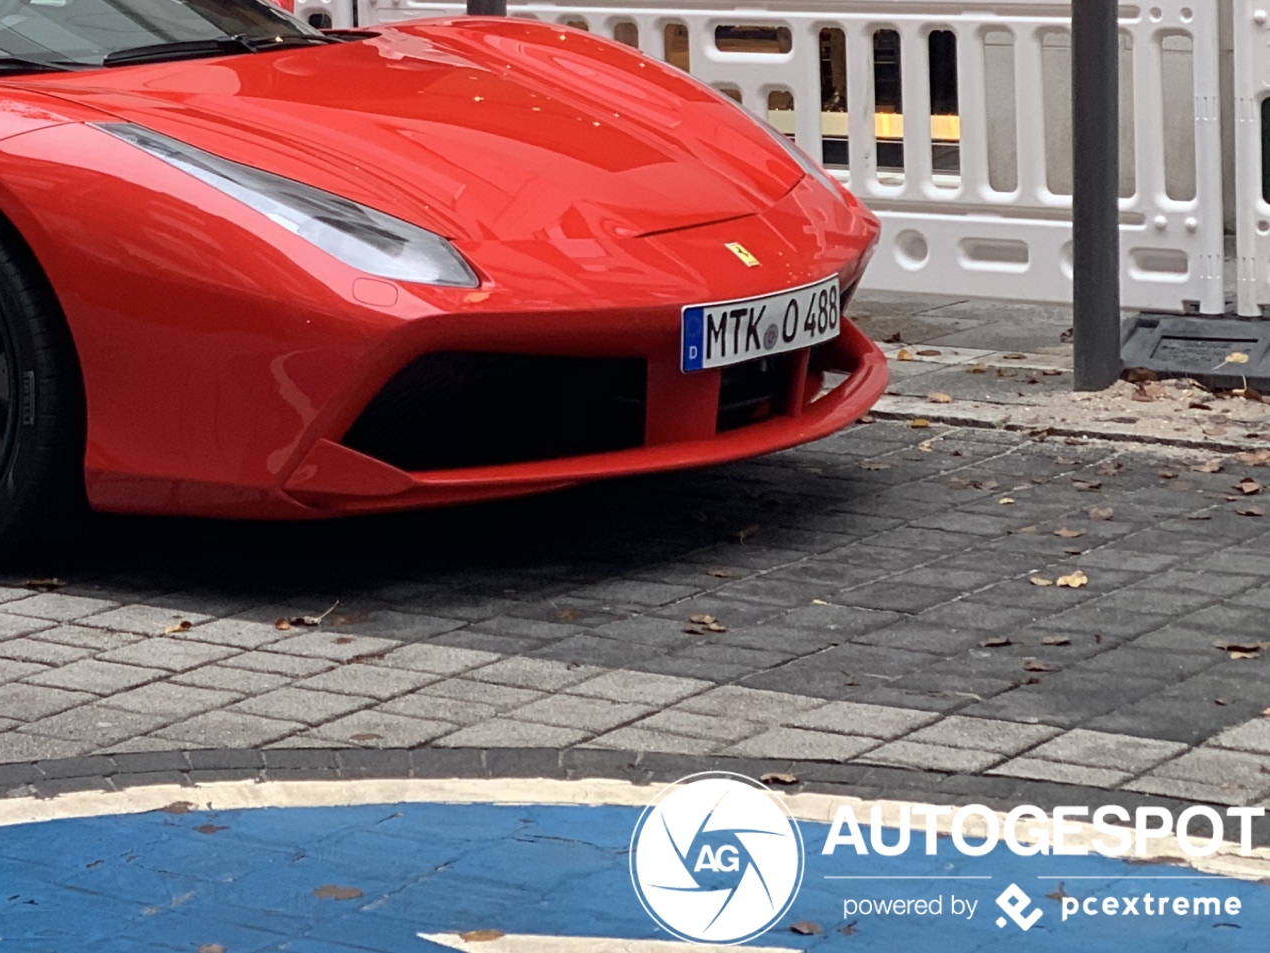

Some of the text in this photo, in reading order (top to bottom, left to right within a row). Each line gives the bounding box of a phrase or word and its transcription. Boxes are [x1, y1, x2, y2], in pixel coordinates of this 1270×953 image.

[706, 305, 767, 360] MTK
[803, 284, 838, 338] 488
[689, 346, 697, 360] D
